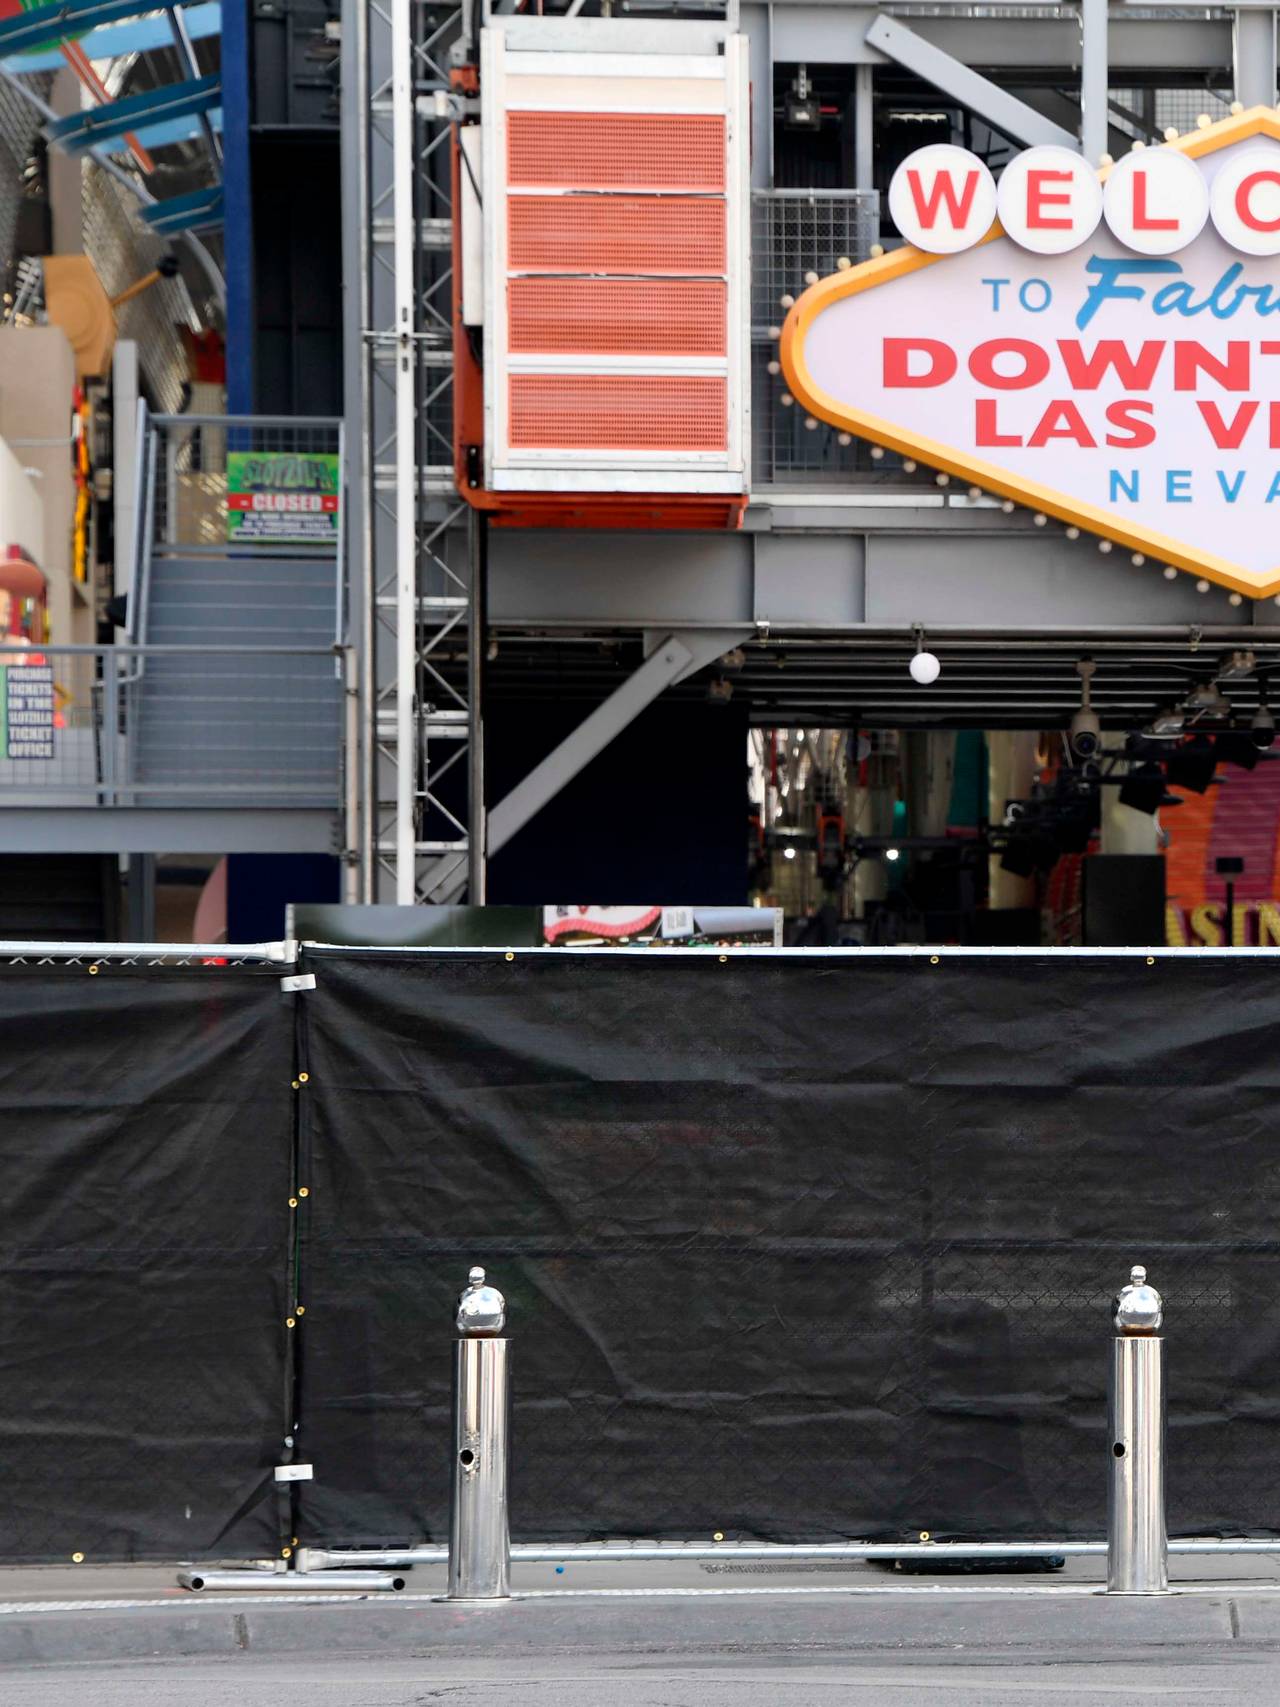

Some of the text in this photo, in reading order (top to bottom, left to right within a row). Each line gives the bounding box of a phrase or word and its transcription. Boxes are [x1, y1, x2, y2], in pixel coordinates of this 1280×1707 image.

[983, 278, 1052, 312] TO
[975, 399, 1157, 449] LAS
[9, 742, 52, 757] OFFICE
